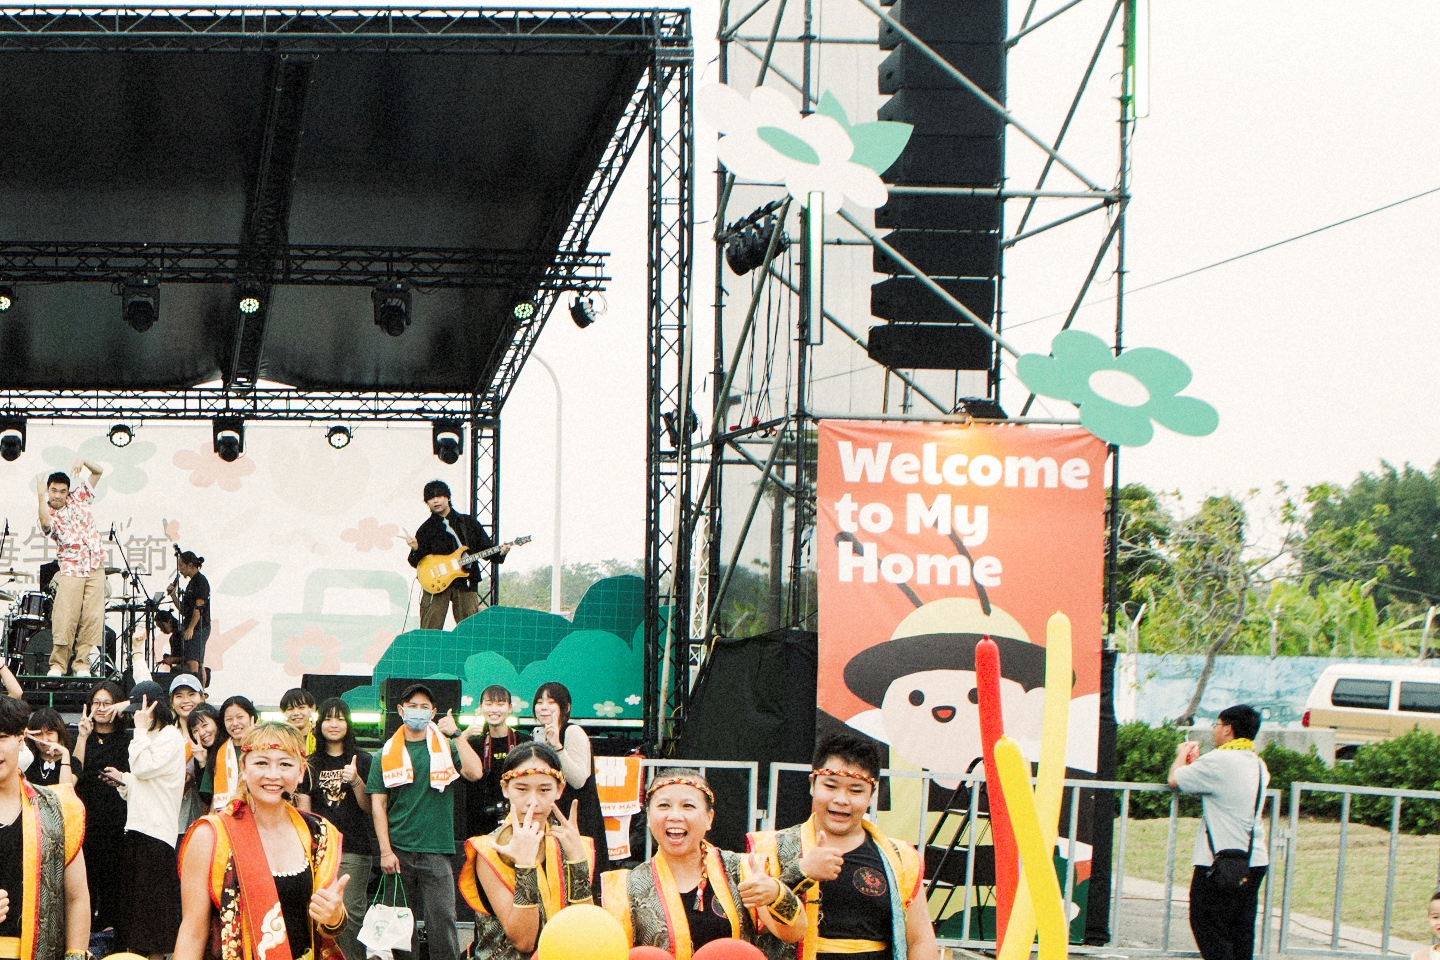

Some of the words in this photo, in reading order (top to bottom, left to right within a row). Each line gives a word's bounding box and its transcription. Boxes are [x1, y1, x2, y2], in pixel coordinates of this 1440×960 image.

[837, 440, 1092, 489] Welcome
[834, 493, 894, 534] to
[906, 493, 989, 546] My
[837, 541, 1003, 586] Home
